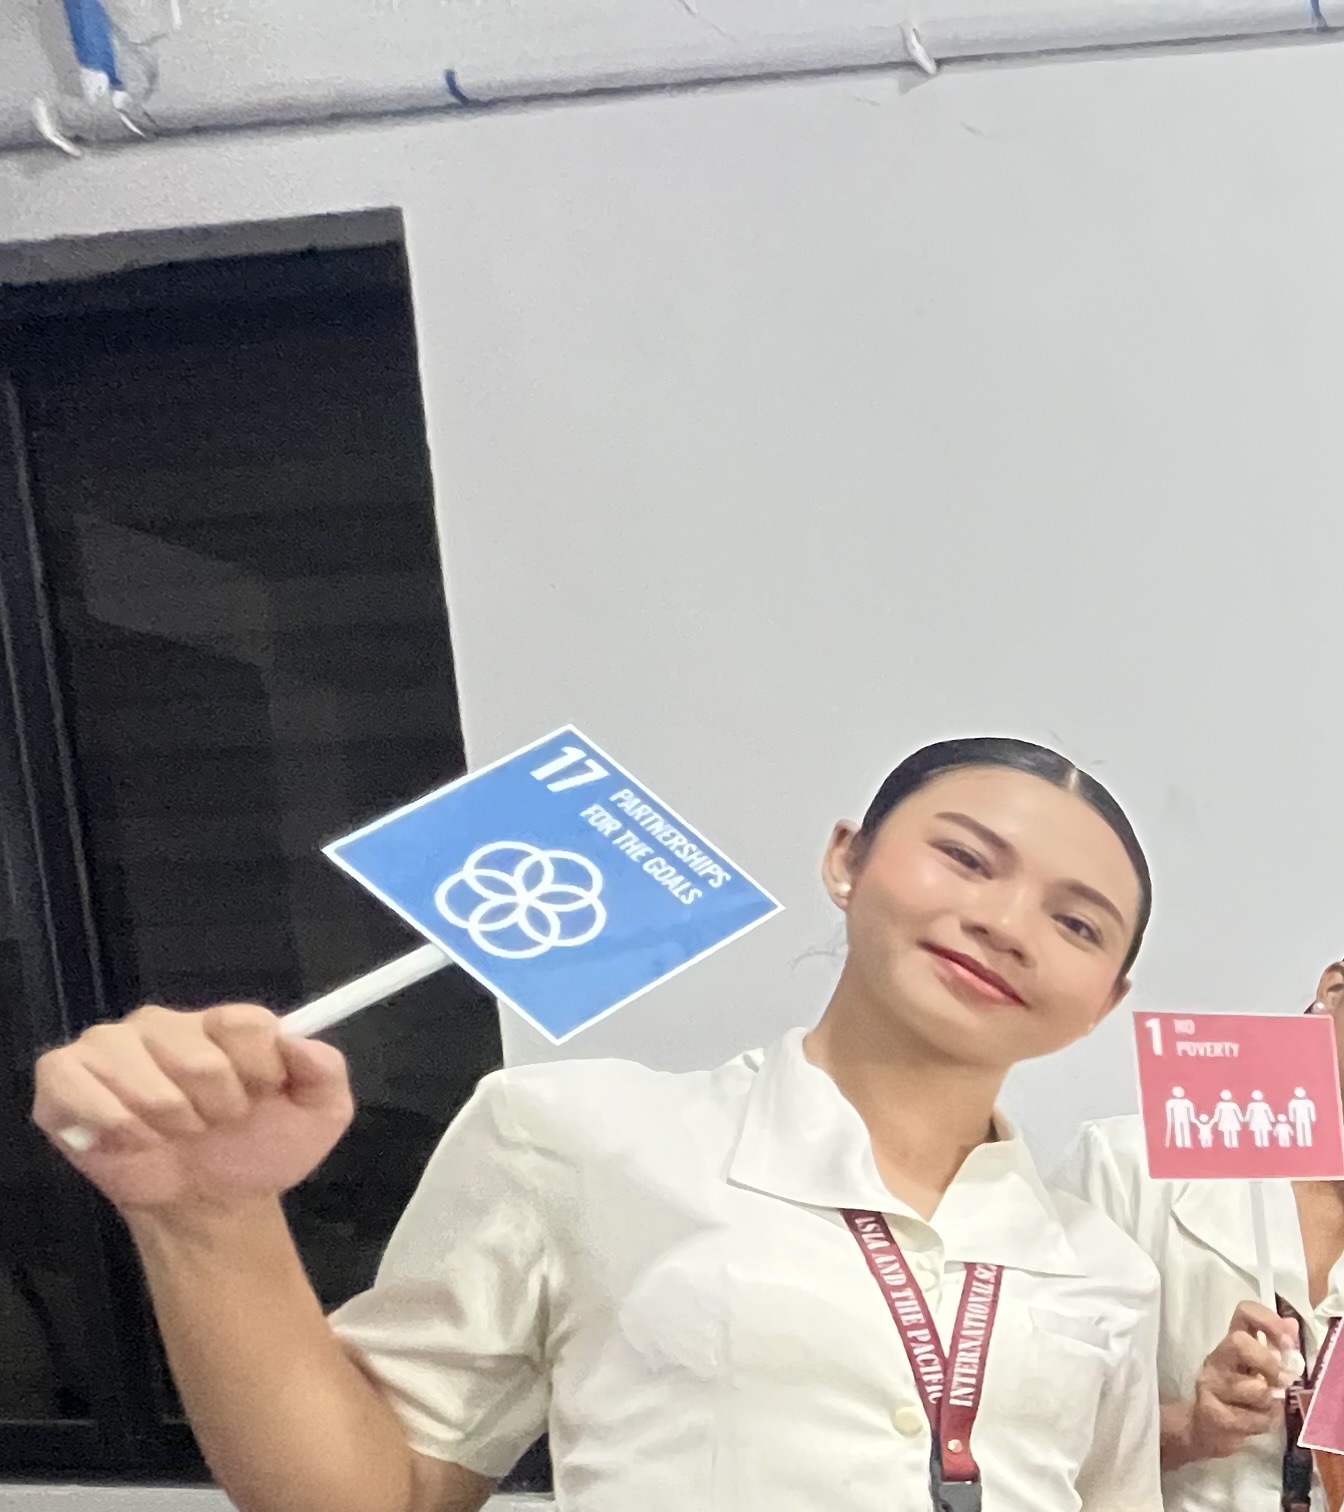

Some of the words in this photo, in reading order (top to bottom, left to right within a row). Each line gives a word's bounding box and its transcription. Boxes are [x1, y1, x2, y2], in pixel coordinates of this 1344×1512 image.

[530, 746, 611, 793] 17
[580, 804, 622, 837] FOR
[613, 830, 655, 864] THE
[643, 857, 702, 905] GOALS
[609, 788, 731, 888] PARTNERSHIPS
[1145, 1018, 1163, 1056] 1
[1174, 1019, 1195, 1034] NO
[1176, 1041, 1240, 1058] POVERTY
[872, 1252, 907, 1286] AND
[890, 1290, 925, 1326] THE
[948, 1281, 995, 1408] INTERNATIONAL
